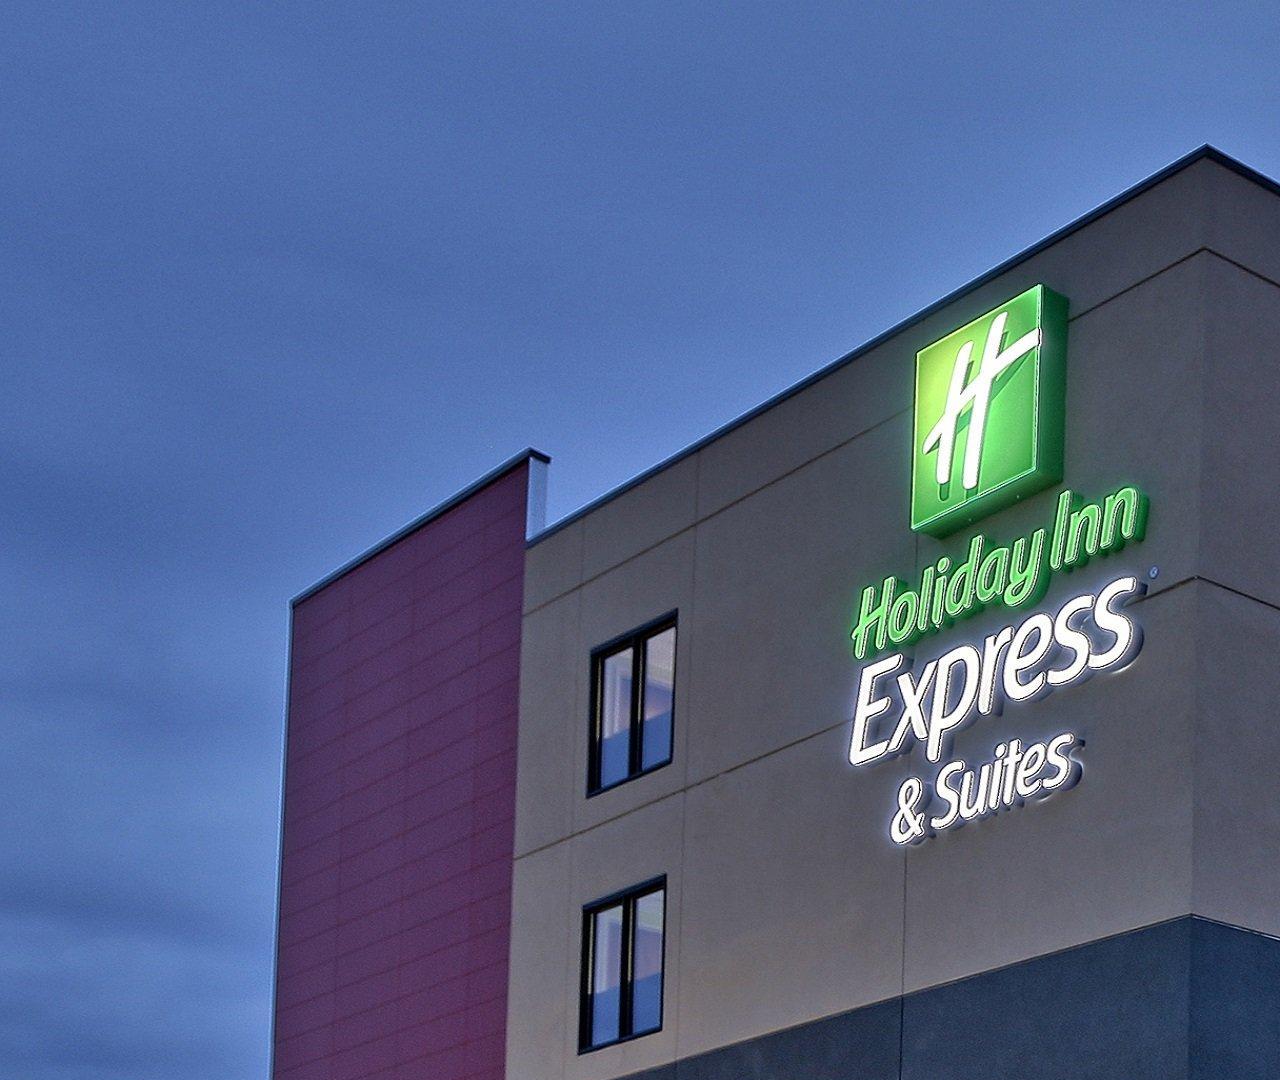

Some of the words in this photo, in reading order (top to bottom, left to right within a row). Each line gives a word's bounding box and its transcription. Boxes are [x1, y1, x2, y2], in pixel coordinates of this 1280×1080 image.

[921, 310, 1043, 491] H
[852, 527, 1047, 661] Holiday
[1048, 485, 1142, 572] Inn
[847, 575, 1140, 767] Express
[889, 777, 926, 846] &
[930, 732, 1078, 831] Suites
